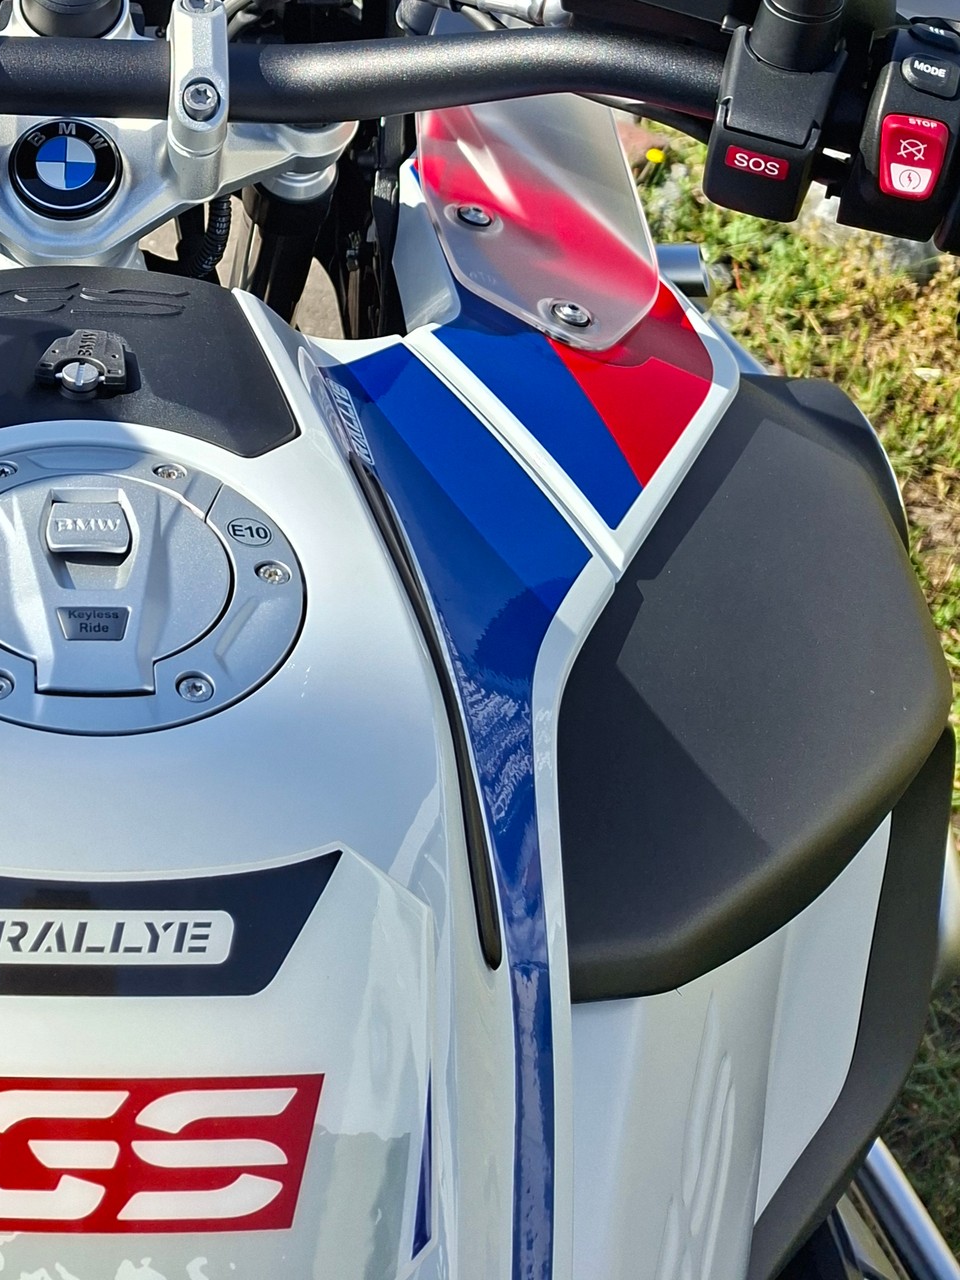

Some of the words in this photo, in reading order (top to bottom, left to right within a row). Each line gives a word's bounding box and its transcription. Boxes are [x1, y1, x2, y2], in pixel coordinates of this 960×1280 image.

[912, 58, 947, 79] MODE
[908, 116, 938, 129] STOP
[26, 121, 108, 150] BMW
[733, 151, 781, 177] SOS
[55, 518, 120, 532] BMW
[230, 522, 269, 540] E10
[68, 609, 120, 621] Keyless
[79, 622, 110, 633] Ride
